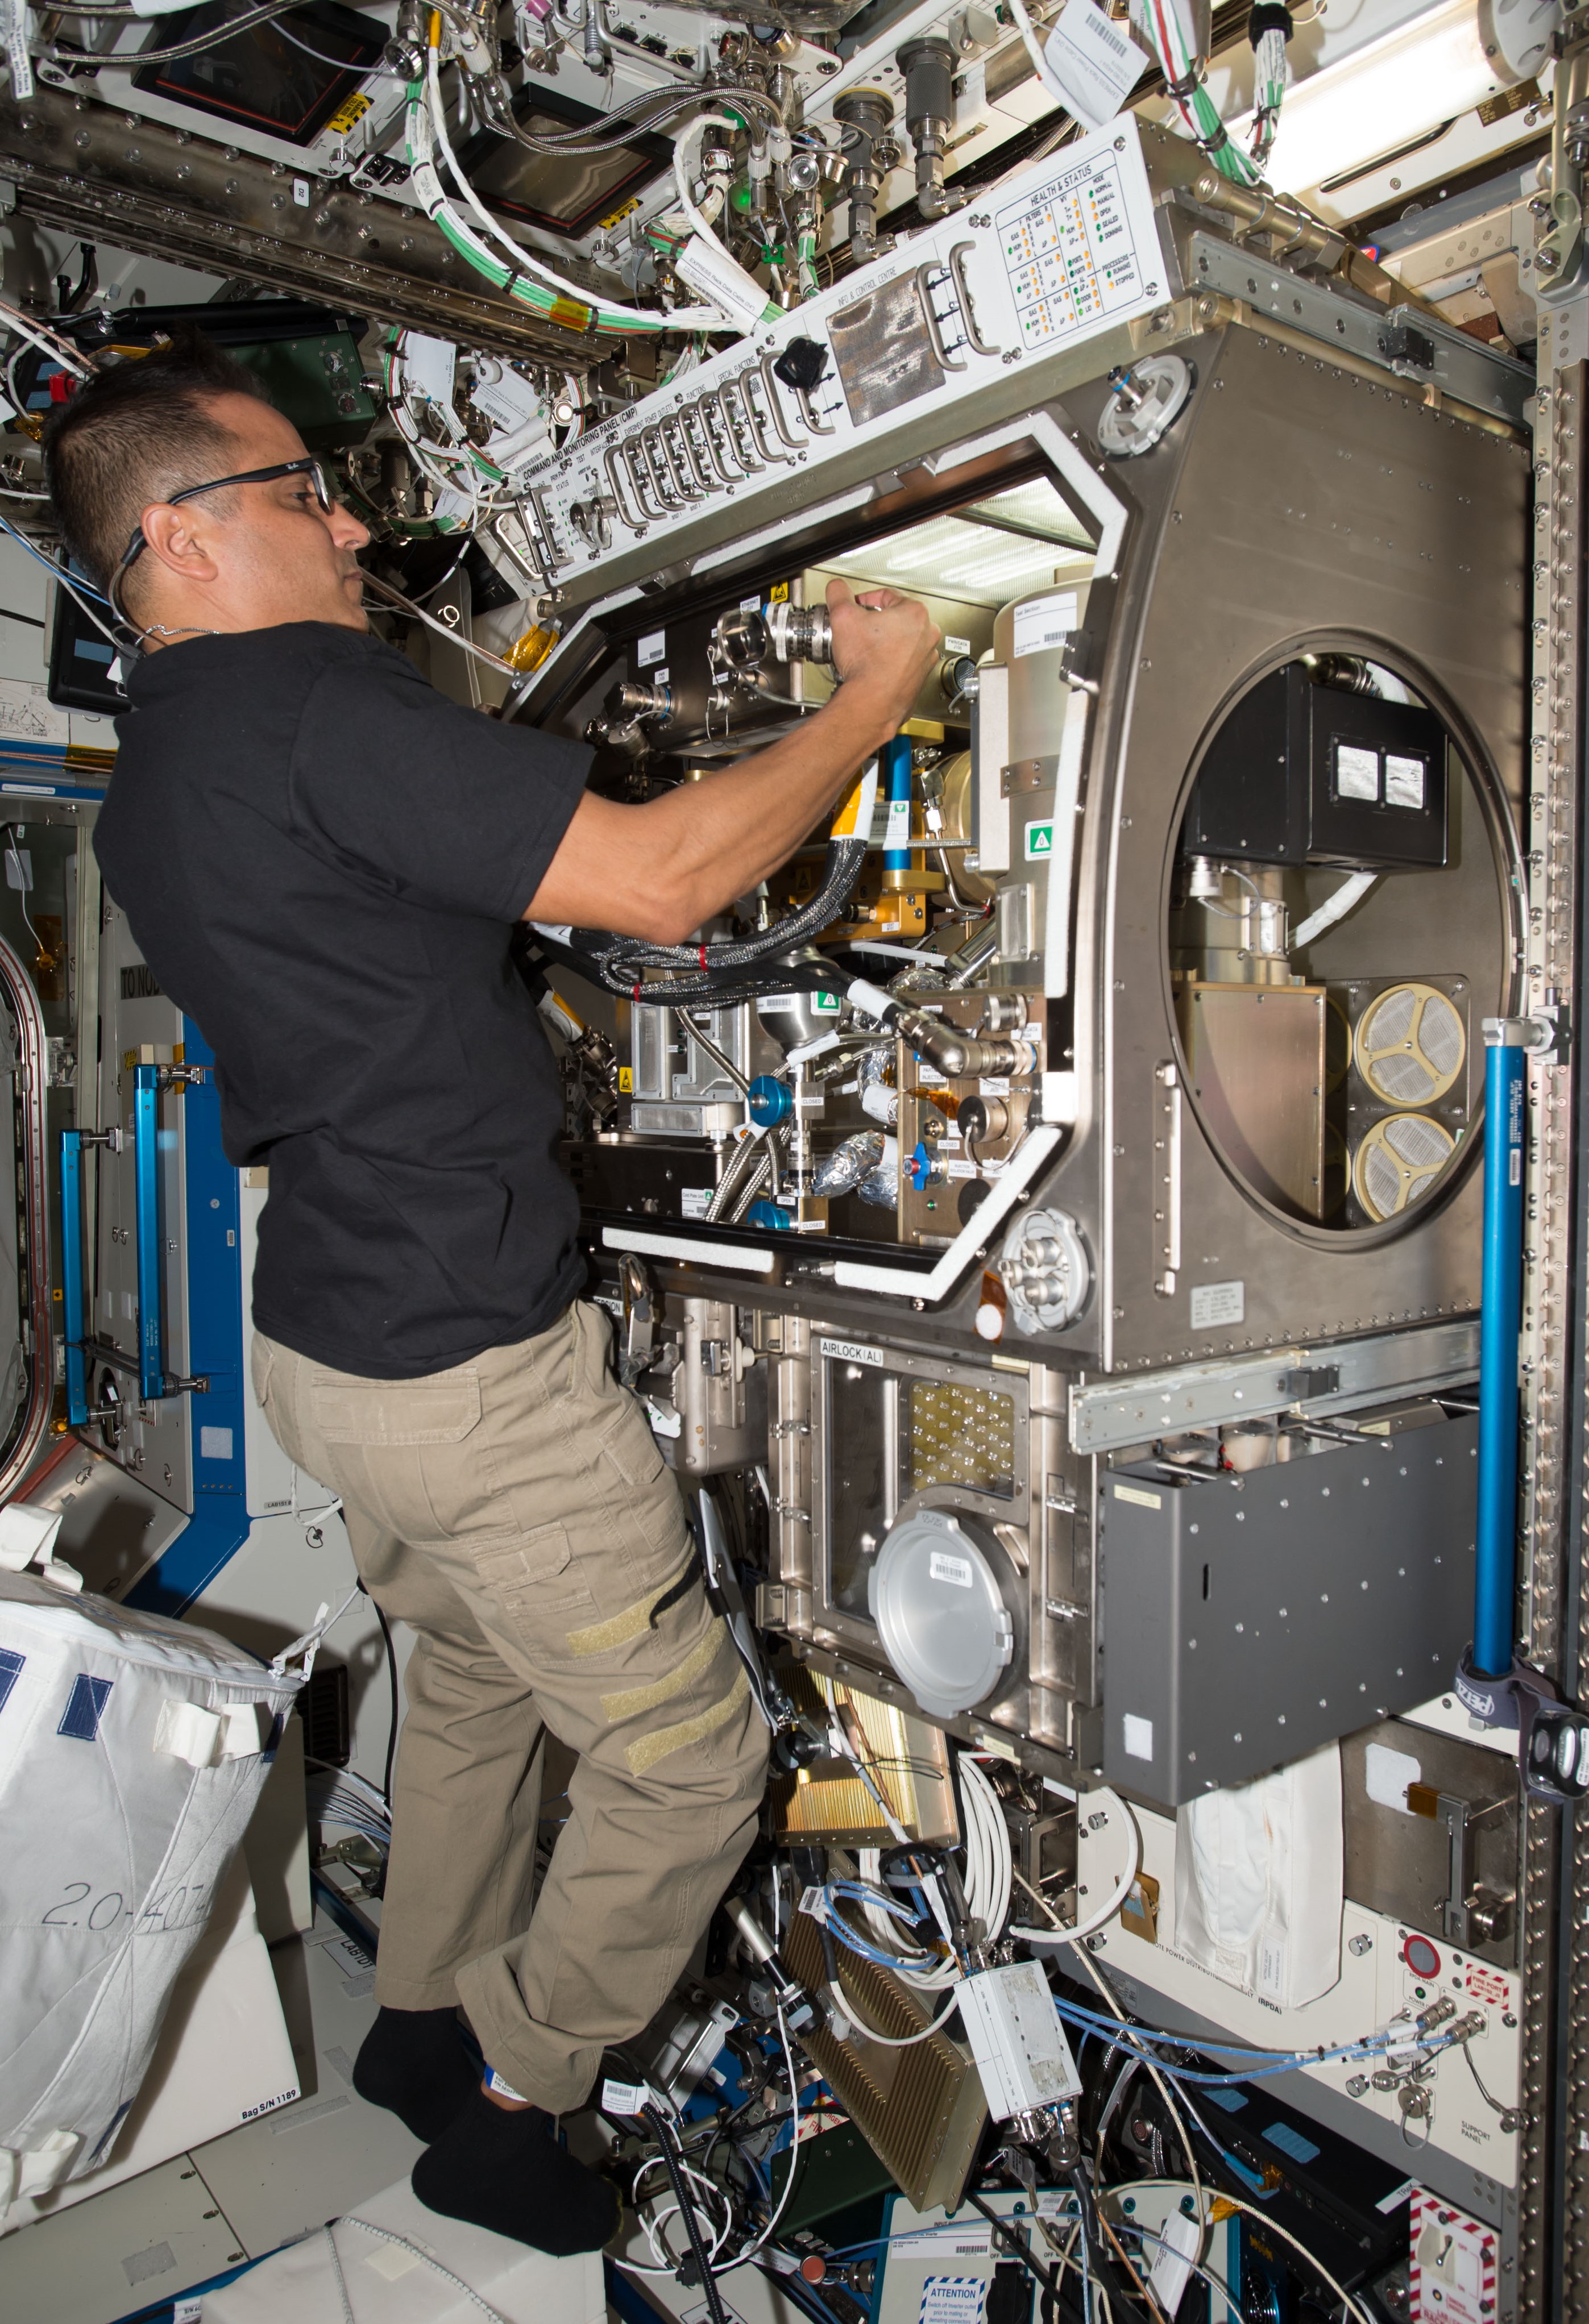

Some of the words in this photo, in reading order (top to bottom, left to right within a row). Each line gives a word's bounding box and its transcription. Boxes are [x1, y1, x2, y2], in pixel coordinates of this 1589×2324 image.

[346, 99, 365, 119] WARNING
[1031, 185, 1057, 206] HEALTH
[1057, 182, 1063, 191] &
[1064, 165, 1092, 188] STATUS
[1093, 174, 1104, 184] MODE
[298, 188, 304, 198] D2
[1095, 181, 1112, 194] NORMAL
[1097, 192, 1115, 205] MANUAL
[1026, 209, 1042, 222] FILTERS
[1100, 206, 1111, 217] OPEN
[1035, 218, 1044, 228] GAS
[1102, 215, 1119, 228] SEALED
[1011, 232, 1019, 241] GAS
[1044, 258, 1053, 267] GAS
[1102, 253, 1129, 272] PROCESSORS
[1113, 261, 1131, 275] RUNNING
[689, 257, 712, 277] EXPRESS
[711, 275, 722, 285] Rack
[722, 284, 732, 294] Data
[733, 292, 745, 304] Cable
[1020, 271, 1028, 280] GAS
[1115, 272, 1135, 286] STOPPED
[838, 294, 849, 307] INFO
[855, 279, 877, 297] CONTROL
[878, 266, 897, 284] CENTRE
[1053, 296, 1062, 305] GAS
[1081, 293, 1092, 304] DOOR
[1028, 308, 1037, 317] GAS
[717, 368, 733, 381] SPECIAL
[733, 355, 756, 372] FUNCTIONS
[686, 384, 707, 401] FUNCTIONS
[624, 419, 645, 437] EXPERIMENT
[645, 414, 657, 426] POWER
[658, 404, 674, 418] OUTLETS
[524, 459, 554, 480] COMMAND
[551, 450, 566, 465] AND
[563, 429, 600, 456] MONITORING
[600, 418, 621, 438] PANEL
[619, 406, 638, 425] (CMP)
[576, 454, 586, 464] TEST
[556, 480, 569, 492] STATUS
[1024, 605, 1041, 614] Section
[122, 968, 135, 998] TO
[138, 967, 159, 996] NOD
[340, 1939, 374, 1969] LAB1D1
[1166, 1948, 1185, 1961] POWER
[1409, 1972, 1421, 1982] RPDA
[1422, 1978, 1435, 1988] MAIN
[1473, 1976, 1486, 1986] FIRE
[1487, 1981, 1501, 1993] PORT
[1258, 1996, 1283, 2015] (RPDA)
[1409, 1996, 1426, 2007] POWER
[242, 2108, 259, 2119] Bag
[259, 2098, 275, 2111] S/N
[277, 2089, 296, 2103] 1189
[809, 2120, 825, 2133] FIR
[1462, 2121, 1491, 2141] SUPPORT
[1461, 2129, 1482, 2146] PANEL
[931, 2288, 976, 2299] ATTENTION
